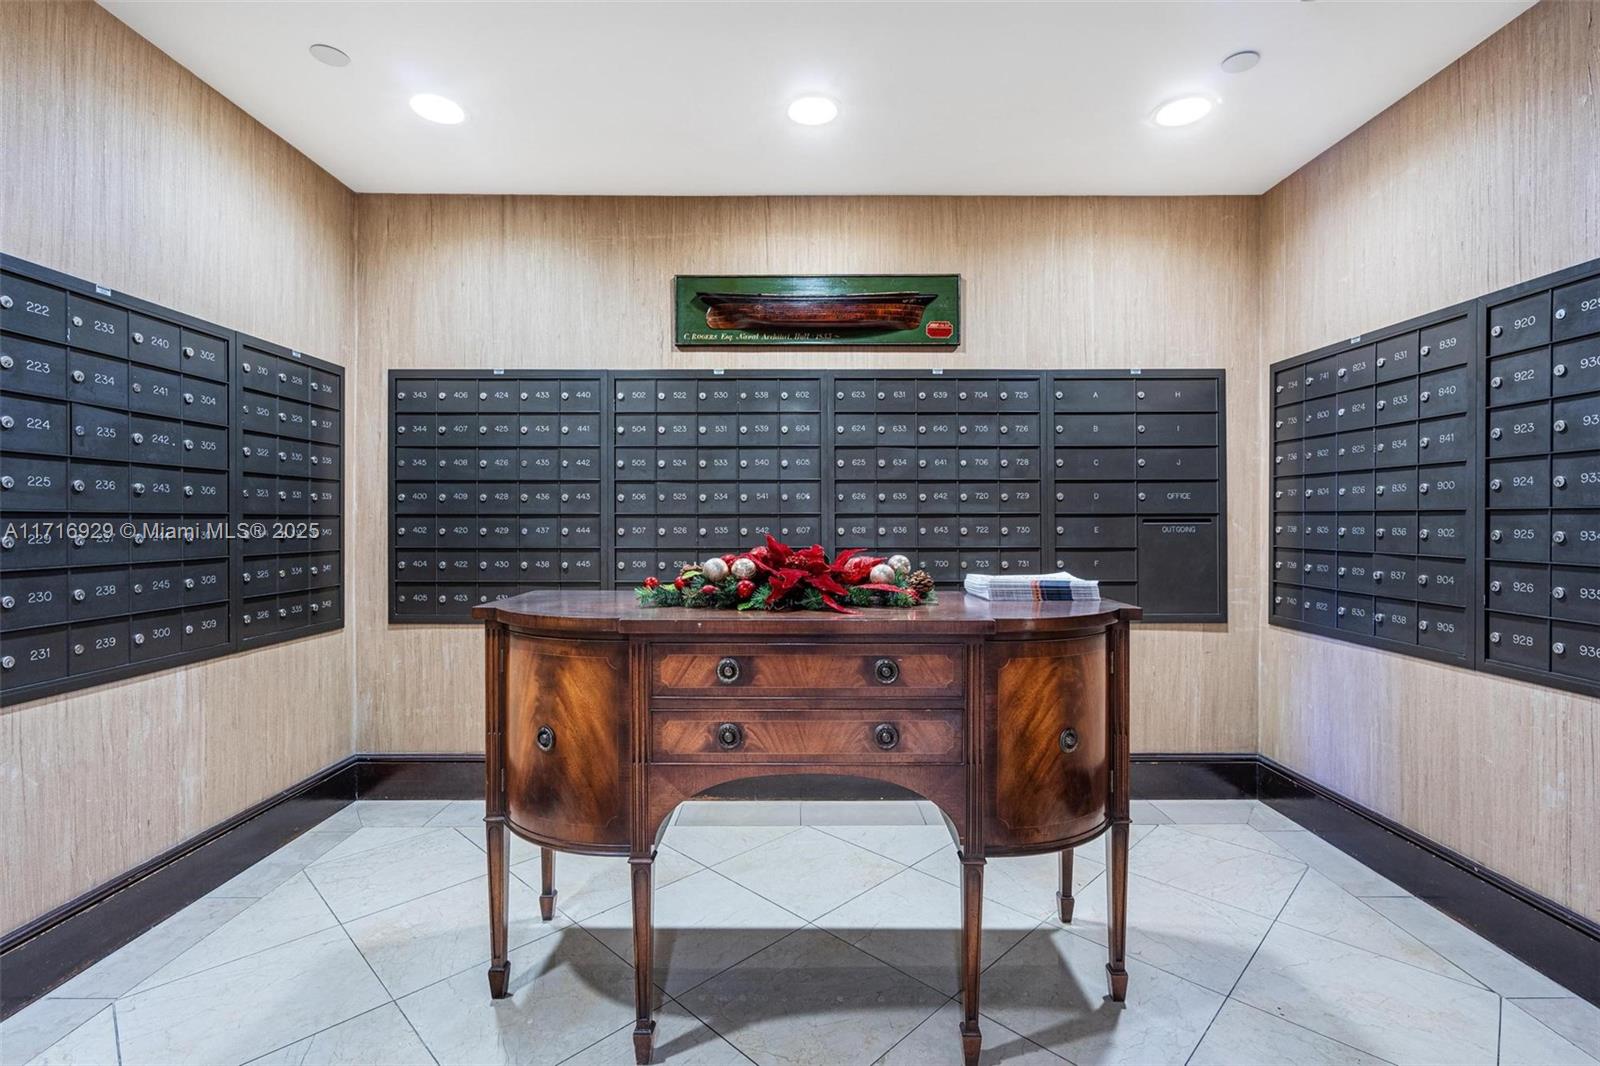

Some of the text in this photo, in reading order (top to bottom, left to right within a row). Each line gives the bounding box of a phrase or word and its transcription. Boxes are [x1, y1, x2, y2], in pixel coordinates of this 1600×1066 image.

[26, 300, 50, 317] 222
[1581, 297, 1600, 312] 92
[1514, 315, 1536, 330] 920
[94, 320, 115, 335] 233
[151, 335, 170, 349] 240
[1439, 337, 1457, 350] 839
[199, 349, 216, 362] 302
[1394, 350, 1408, 361] 831
[26, 359, 51, 374] 223
[94, 373, 115, 386] 234
[1513, 369, 1535, 382] 922
[152, 384, 169, 396] 241
[795, 390, 810, 399] 602
[851, 390, 866, 399] 623
[893, 390, 906, 399] 631
[1438, 385, 1457, 397] 840
[412, 391, 428, 399] 343
[453, 391, 468, 399] 406
[494, 391, 509, 399] 424
[535, 391, 550, 399] 433
[575, 391, 592, 399] 440
[631, 391, 646, 399] 502
[673, 391, 687, 399] 522
[713, 391, 729, 399] 530
[754, 391, 769, 399] 538
[933, 391, 948, 399] 639
[974, 391, 989, 399] 704
[1014, 391, 1029, 399] 725
[200, 394, 216, 406] 304
[1392, 394, 1409, 406] 833
[1316, 409, 1330, 420] 800
[26, 417, 51, 430] 224
[1582, 413, 1600, 426] 93
[96, 426, 117, 438] 235
[412, 425, 428, 433] 344
[453, 425, 468, 433] 407
[494, 425, 509, 433] 425
[535, 425, 550, 433] 434
[631, 425, 647, 433] 504
[672, 425, 687, 433] 523
[714, 425, 728, 433] 531
[754, 424, 769, 433] 539
[794, 424, 811, 432] 604
[851, 424, 866, 432] 624
[932, 424, 949, 433] 640
[1015, 424, 1029, 433] 726
[1092, 424, 1099, 433] B
[1513, 422, 1535, 434] 923
[151, 433, 170, 445] 242
[1439, 432, 1455, 444] 841
[200, 440, 217, 451] 305
[1391, 439, 1407, 449] 834
[412, 458, 428, 466] 345
[575, 458, 591, 467] 442
[631, 459, 647, 467] 505
[672, 458, 687, 467] 524
[754, 458, 770, 466] 540
[892, 458, 907, 466] 634
[934, 458, 947, 466] 641
[974, 458, 989, 466] 706
[1093, 458, 1099, 467] C
[1176, 458, 1181, 466] J
[27, 475, 51, 488] 225
[95, 479, 116, 491] 236
[1437, 480, 1456, 490] 900
[1513, 475, 1534, 487] 924
[152, 483, 171, 493] 243
[200, 485, 217, 496] 306
[1391, 482, 1407, 493] 835
[412, 492, 428, 500] 400
[575, 492, 591, 501] 443
[631, 492, 647, 501] 506
[756, 492, 769, 500] 541
[851, 492, 866, 501] 626
[933, 492, 948, 500] 642
[1015, 492, 1030, 500] 729
[1093, 492, 1100, 500] D
[1166, 492, 1191, 500] OFFICE
[412, 526, 428, 534] 402
[535, 526, 550, 534] 437
[632, 526, 647, 534] 507
[714, 526, 729, 534] 535
[795, 526, 811, 535] 607
[975, 525, 989, 534] 722
[1093, 526, 1099, 534] E
[1161, 525, 1196, 534] OUTGOING
[1391, 527, 1407, 536] 836
[1437, 527, 1455, 538] 902
[1513, 528, 1535, 540] 925
[412, 560, 428, 568] 404
[934, 559, 949, 568] 700
[975, 559, 990, 568] 723
[1017, 559, 1030, 568] 731
[1093, 559, 1100, 567] F
[200, 574, 217, 585] 308
[1390, 570, 1407, 580] 837
[1436, 574, 1455, 585] 904
[152, 579, 170, 591] 245
[1512, 581, 1534, 593] 926
[95, 584, 117, 597] 238
[28, 590, 53, 604] 230
[453, 594, 469, 602] 423
[1391, 614, 1407, 625] 838
[201, 619, 217, 630] 309
[1436, 621, 1455, 633] 905
[152, 627, 171, 639] 300
[95, 636, 117, 649] 239
[1512, 633, 1534, 647] 928
[30, 647, 50, 661] 231
